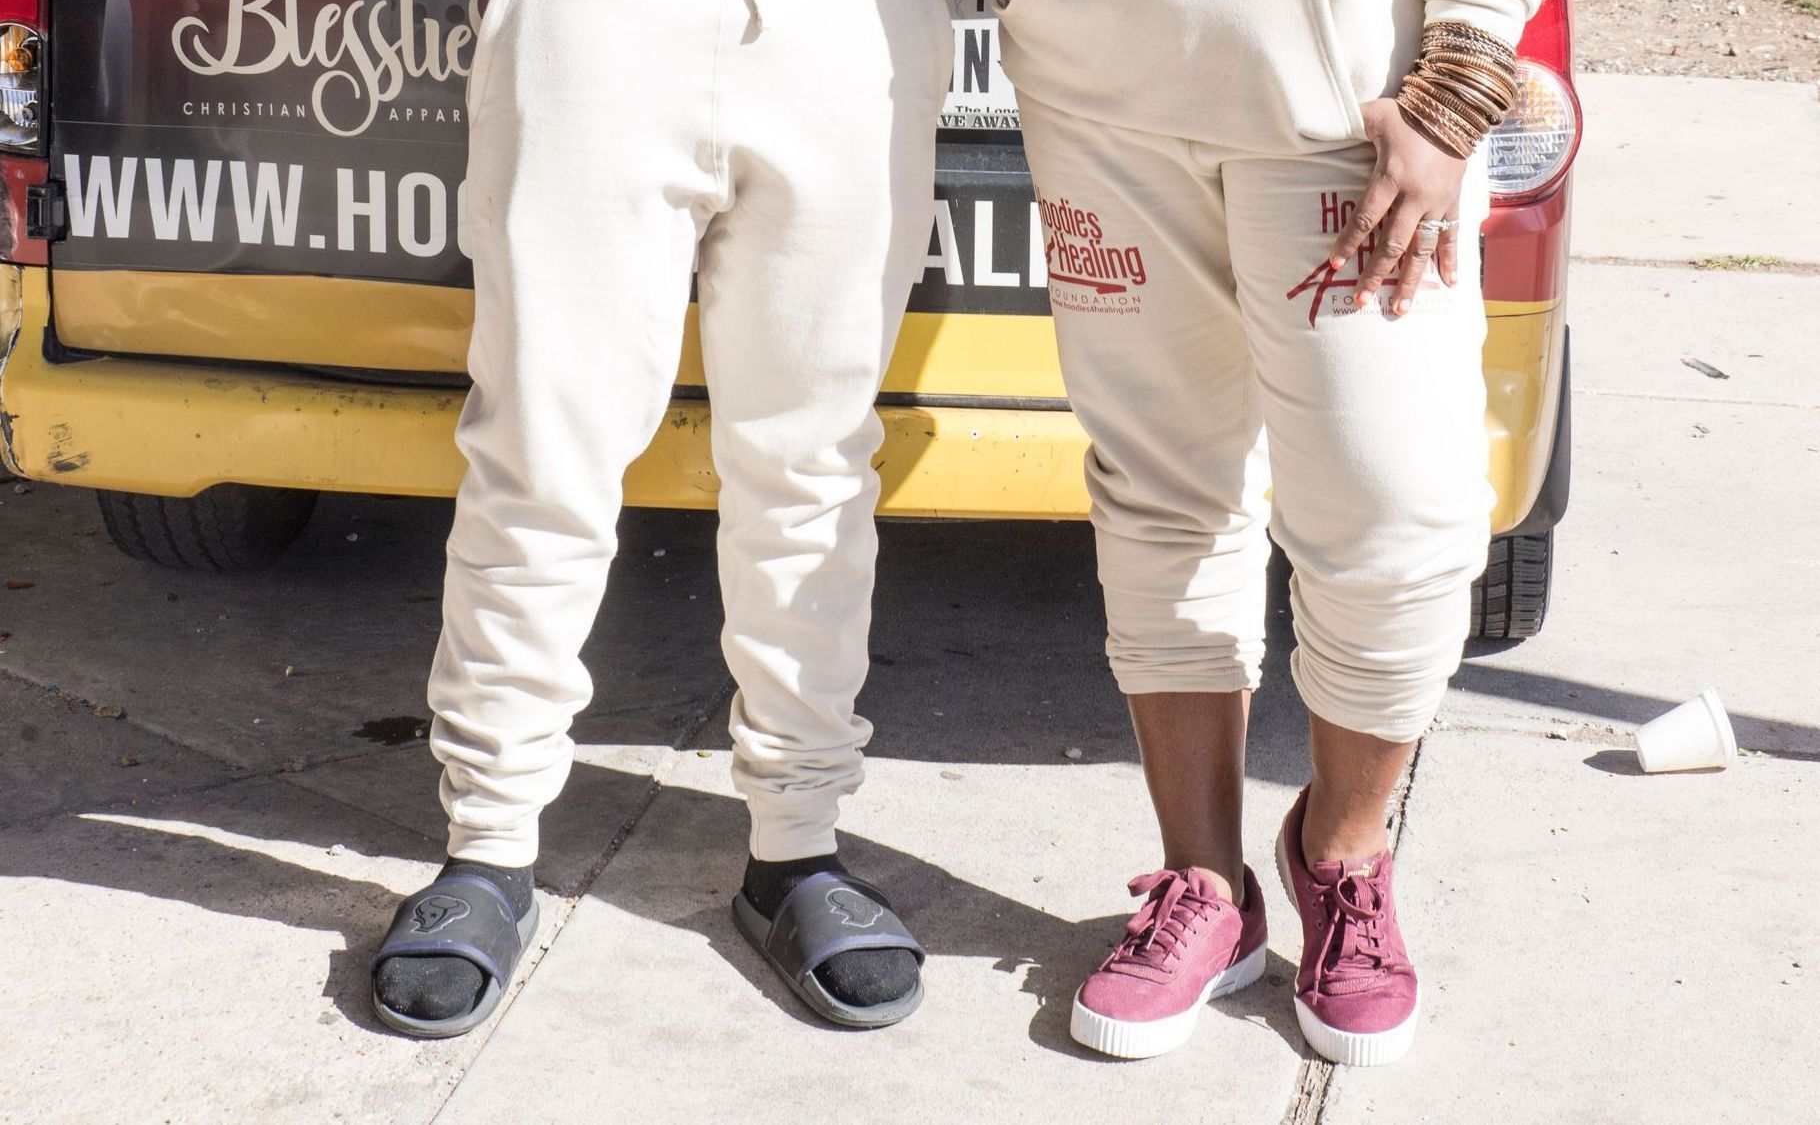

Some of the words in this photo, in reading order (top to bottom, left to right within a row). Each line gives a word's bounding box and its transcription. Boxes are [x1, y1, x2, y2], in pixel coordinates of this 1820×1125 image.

[182, 101, 306, 118] CHRISTIAN
[63, 154, 474, 262] WWW.HO
[1054, 230, 1146, 286] Healing
